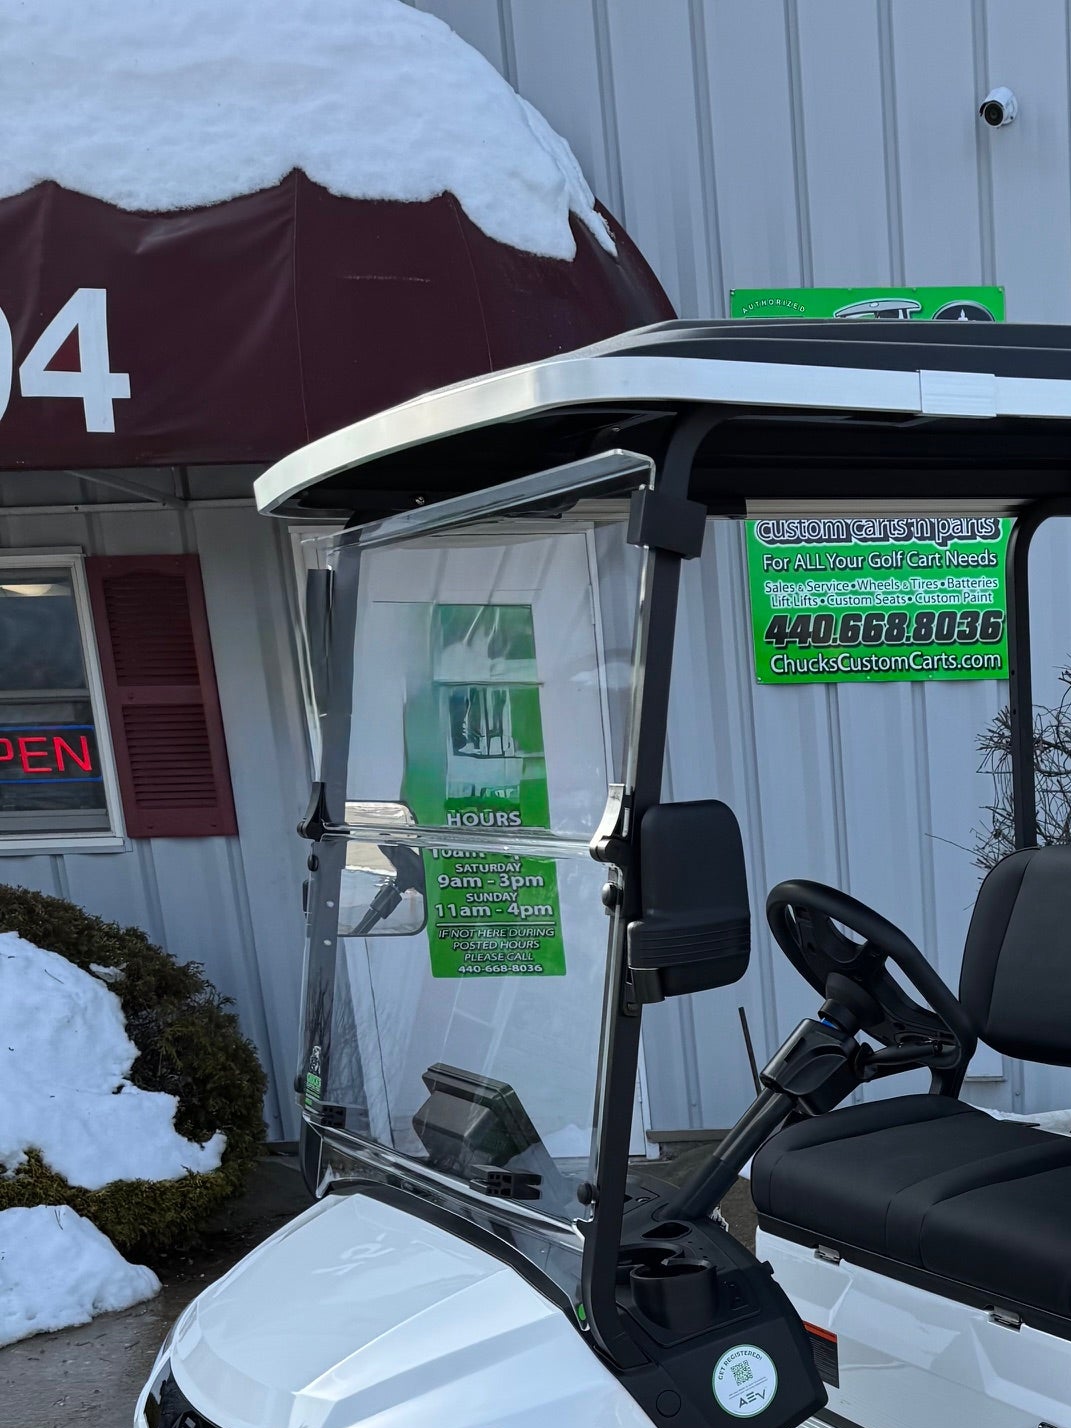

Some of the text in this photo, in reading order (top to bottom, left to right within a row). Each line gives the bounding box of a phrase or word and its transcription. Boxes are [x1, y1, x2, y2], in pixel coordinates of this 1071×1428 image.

[742, 299, 805, 314] AUTHORIZED
[0, 288, 131, 433] 4
[757, 519, 850, 542] custom
[850, 519, 910, 541] carts
[933, 518, 1000, 545] parts
[763, 548, 998, 571] For ALL Your Golf Cart Needs
[765, 581, 795, 594] Sales
[946, 576, 998, 590] Batteries
[771, 595, 793, 608] Lift
[827, 594, 873, 606] Custom
[875, 593, 907, 605] Seats
[915, 592, 960, 604] Custom
[963, 591, 993, 603] Paint
[764, 610, 1004, 647] 440.668.8036
[771, 652, 1001, 673] ChucksCustomCarts.com
[446, 811, 522, 826] HOURS
[455, 862, 522, 873] SATURDAY
[437, 874, 482, 888] 9am
[499, 873, 544, 890] 3pm
[466, 892, 518, 902] SUNDAY
[435, 903, 491, 917] 11am
[507, 902, 553, 918] 4pm
[438, 927, 555, 938] IF NOT HERE DURING
[453, 940, 540, 950] POSTED HOURS
[464, 952, 533, 962] PLEASE CALL
[458, 964, 543, 973] 440-668-8036
[717, 1366, 726, 1380] GET
[739, 1388, 766, 1408] AEV
